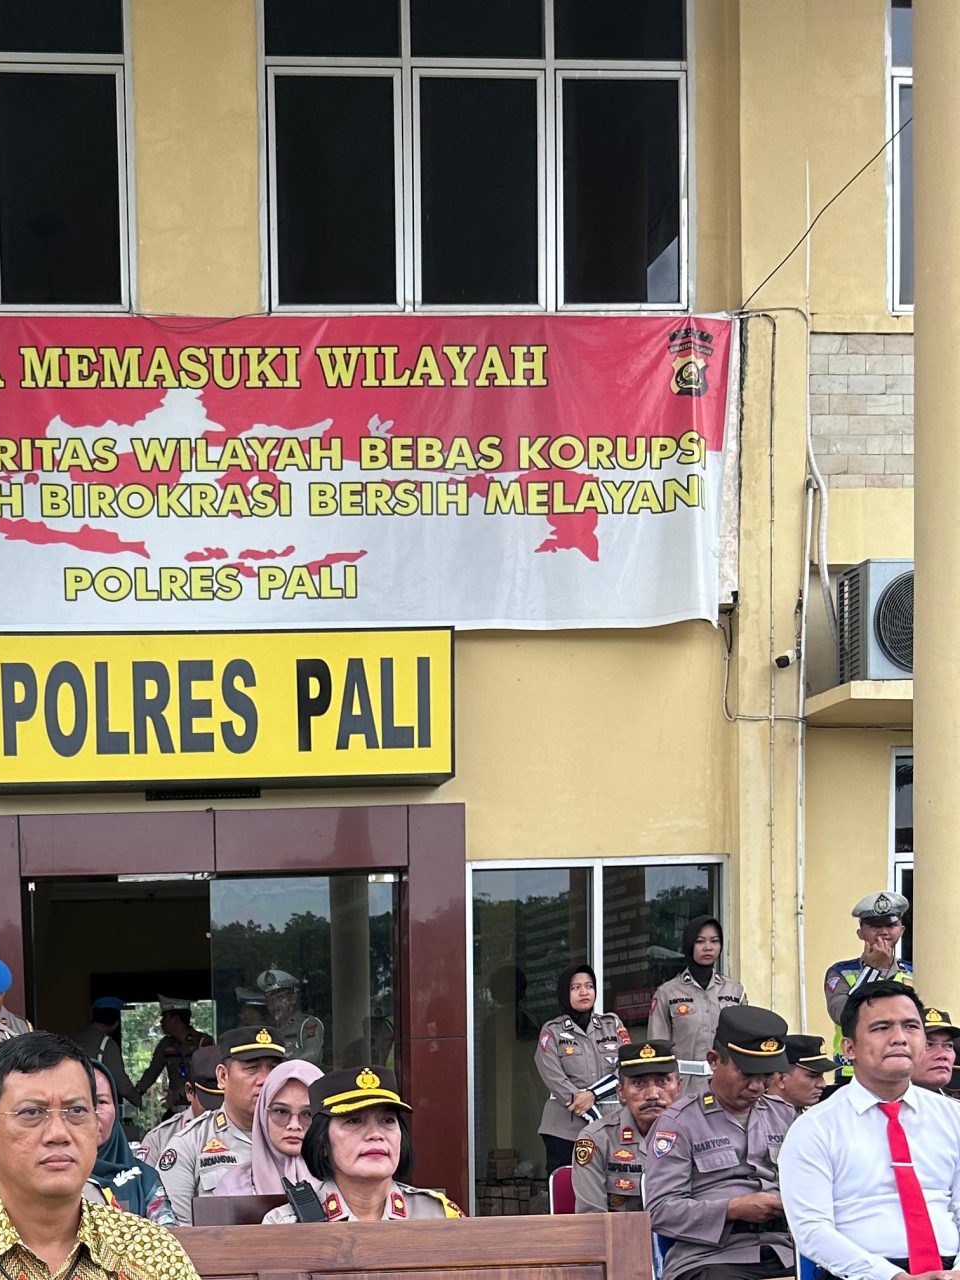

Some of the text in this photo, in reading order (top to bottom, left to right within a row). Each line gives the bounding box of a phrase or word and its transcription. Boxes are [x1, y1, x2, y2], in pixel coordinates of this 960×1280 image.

[19, 346, 301, 389] MEMASUKI
[317, 345, 548, 388] WILAYAH
[130, 436, 343, 472] WILAYAH
[359, 435, 503, 471] BEBAS
[41, 481, 292, 518] BIROKRASI
[309, 481, 469, 517] BERSIH
[63, 565, 357, 601] POLRES PALI
[0, 656, 431, 757] POLRES PALI
